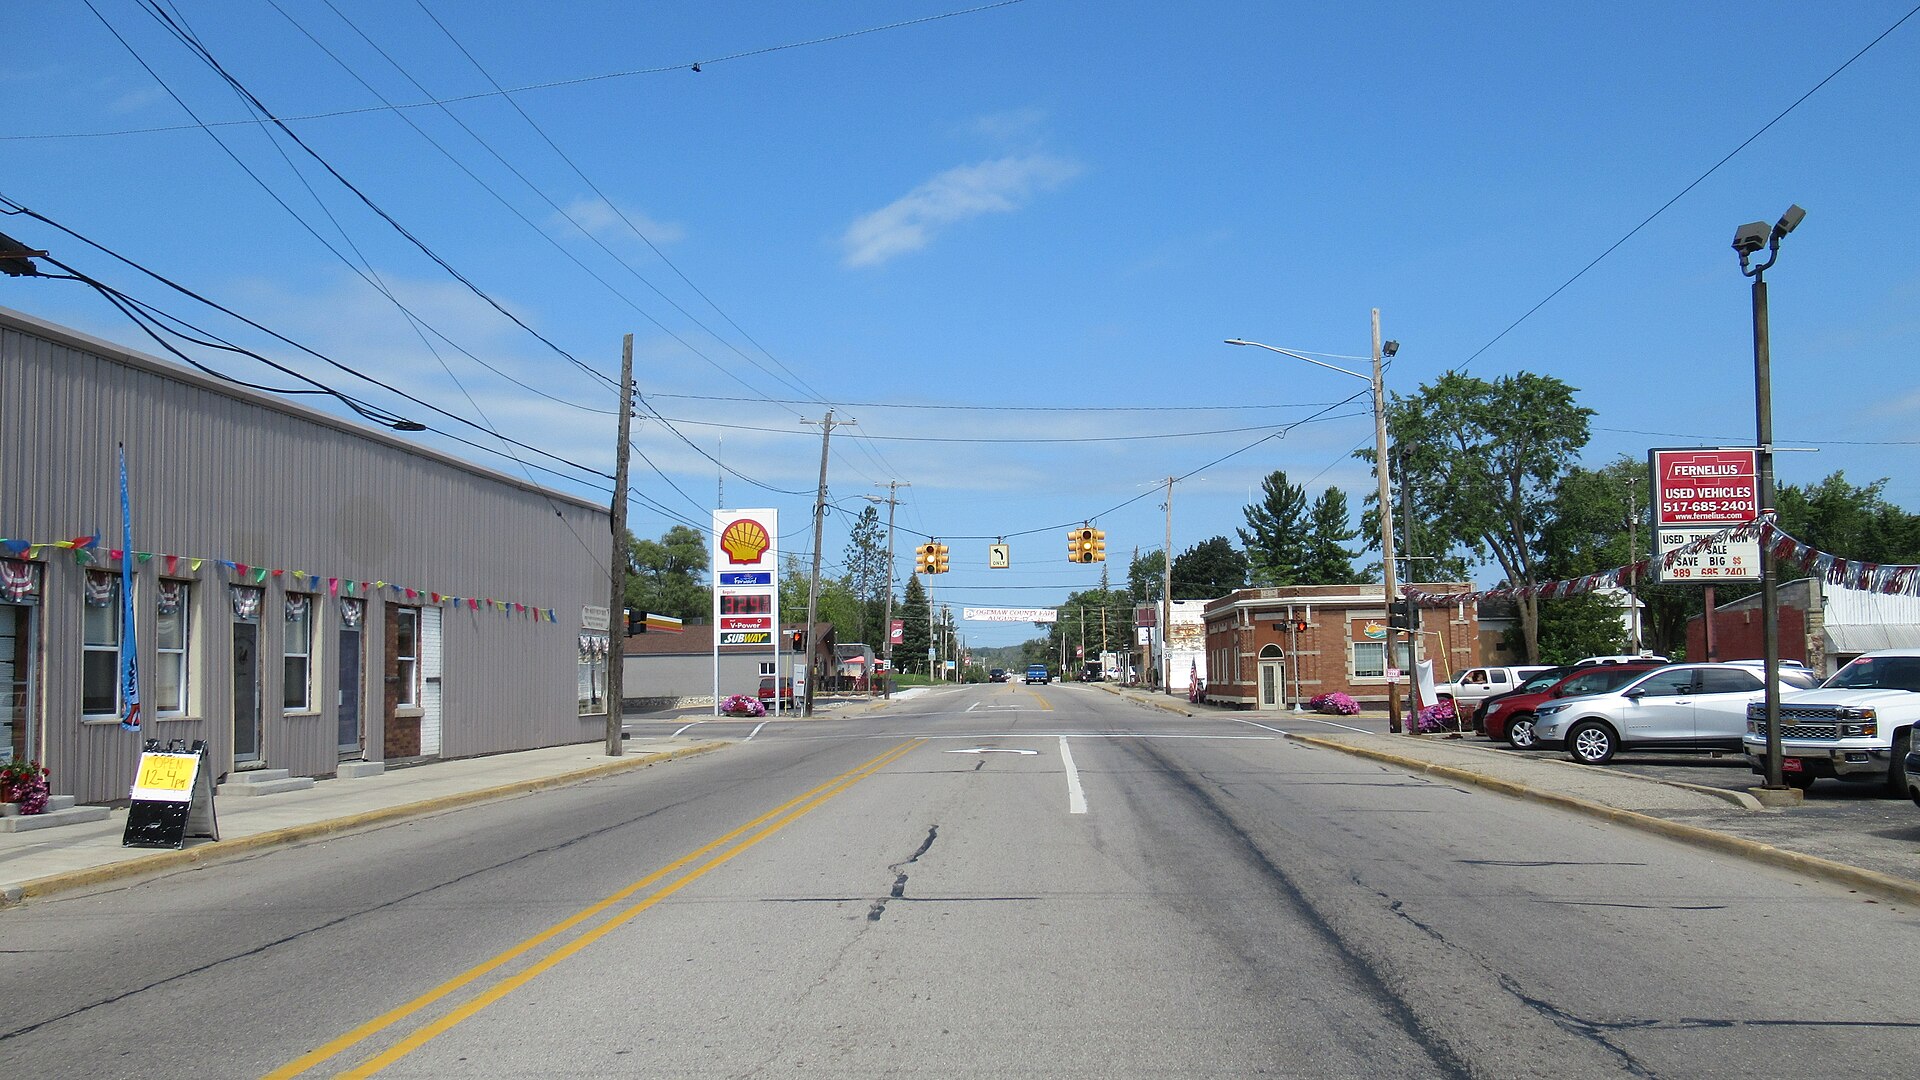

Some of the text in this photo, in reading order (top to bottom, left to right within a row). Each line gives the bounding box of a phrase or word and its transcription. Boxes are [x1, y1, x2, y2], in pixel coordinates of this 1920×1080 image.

[1674, 464, 1738, 476] FERNELIUS
[1665, 486, 1751, 499] USED VEHICLES
[1663, 500, 1754, 512] 517-685-2401
[1675, 512, 1743, 520] www.fernelius.com
[1663, 534, 1684, 545] USED
[1706, 545, 1727, 555] SALE
[1676, 556, 1699, 566] SAVE
[1709, 556, 1726, 566] BIG
[1673, 567, 1747, 578] 989 685 2401
[723, 633, 768, 644] SUBWAY
[154, 757, 184, 770] OPEN
